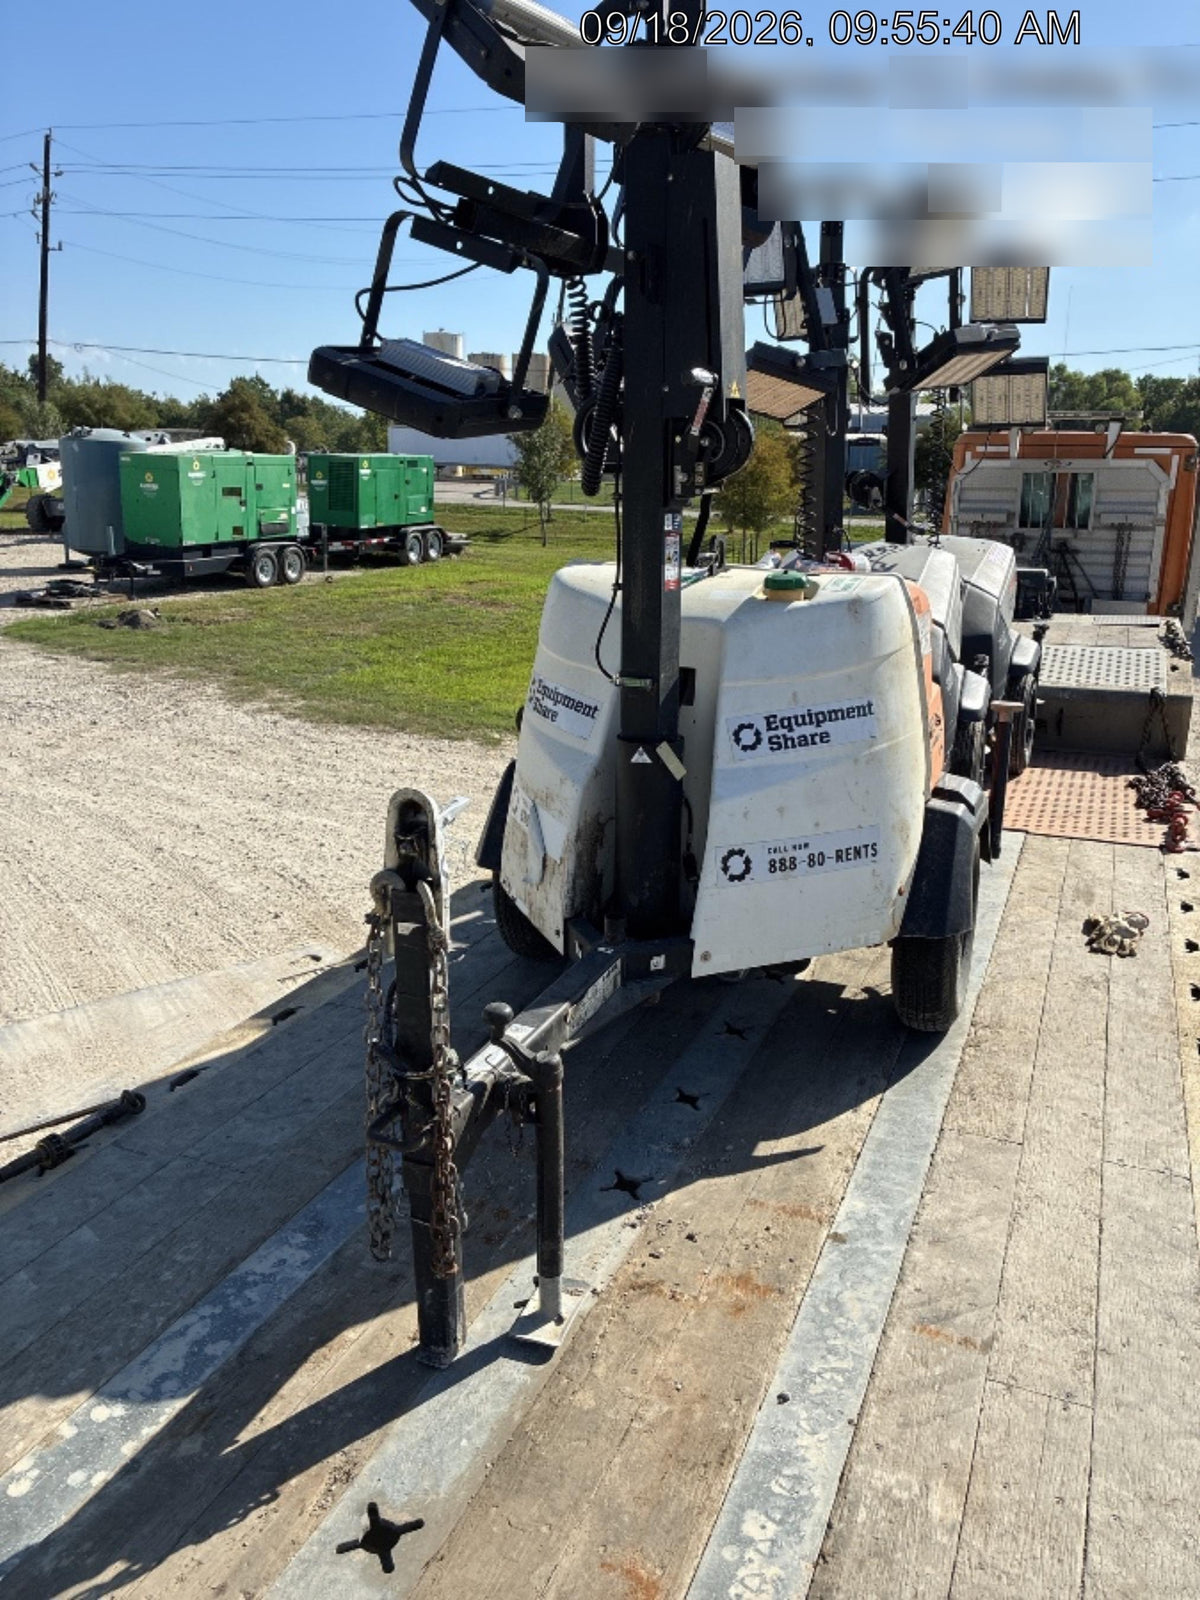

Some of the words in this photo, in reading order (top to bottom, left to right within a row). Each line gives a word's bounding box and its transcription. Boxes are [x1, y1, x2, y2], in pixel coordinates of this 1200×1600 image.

[763, 700, 875, 732] Equipment
[767, 731, 831, 752] Share
[768, 842, 878, 874] 888-80-RENTS
